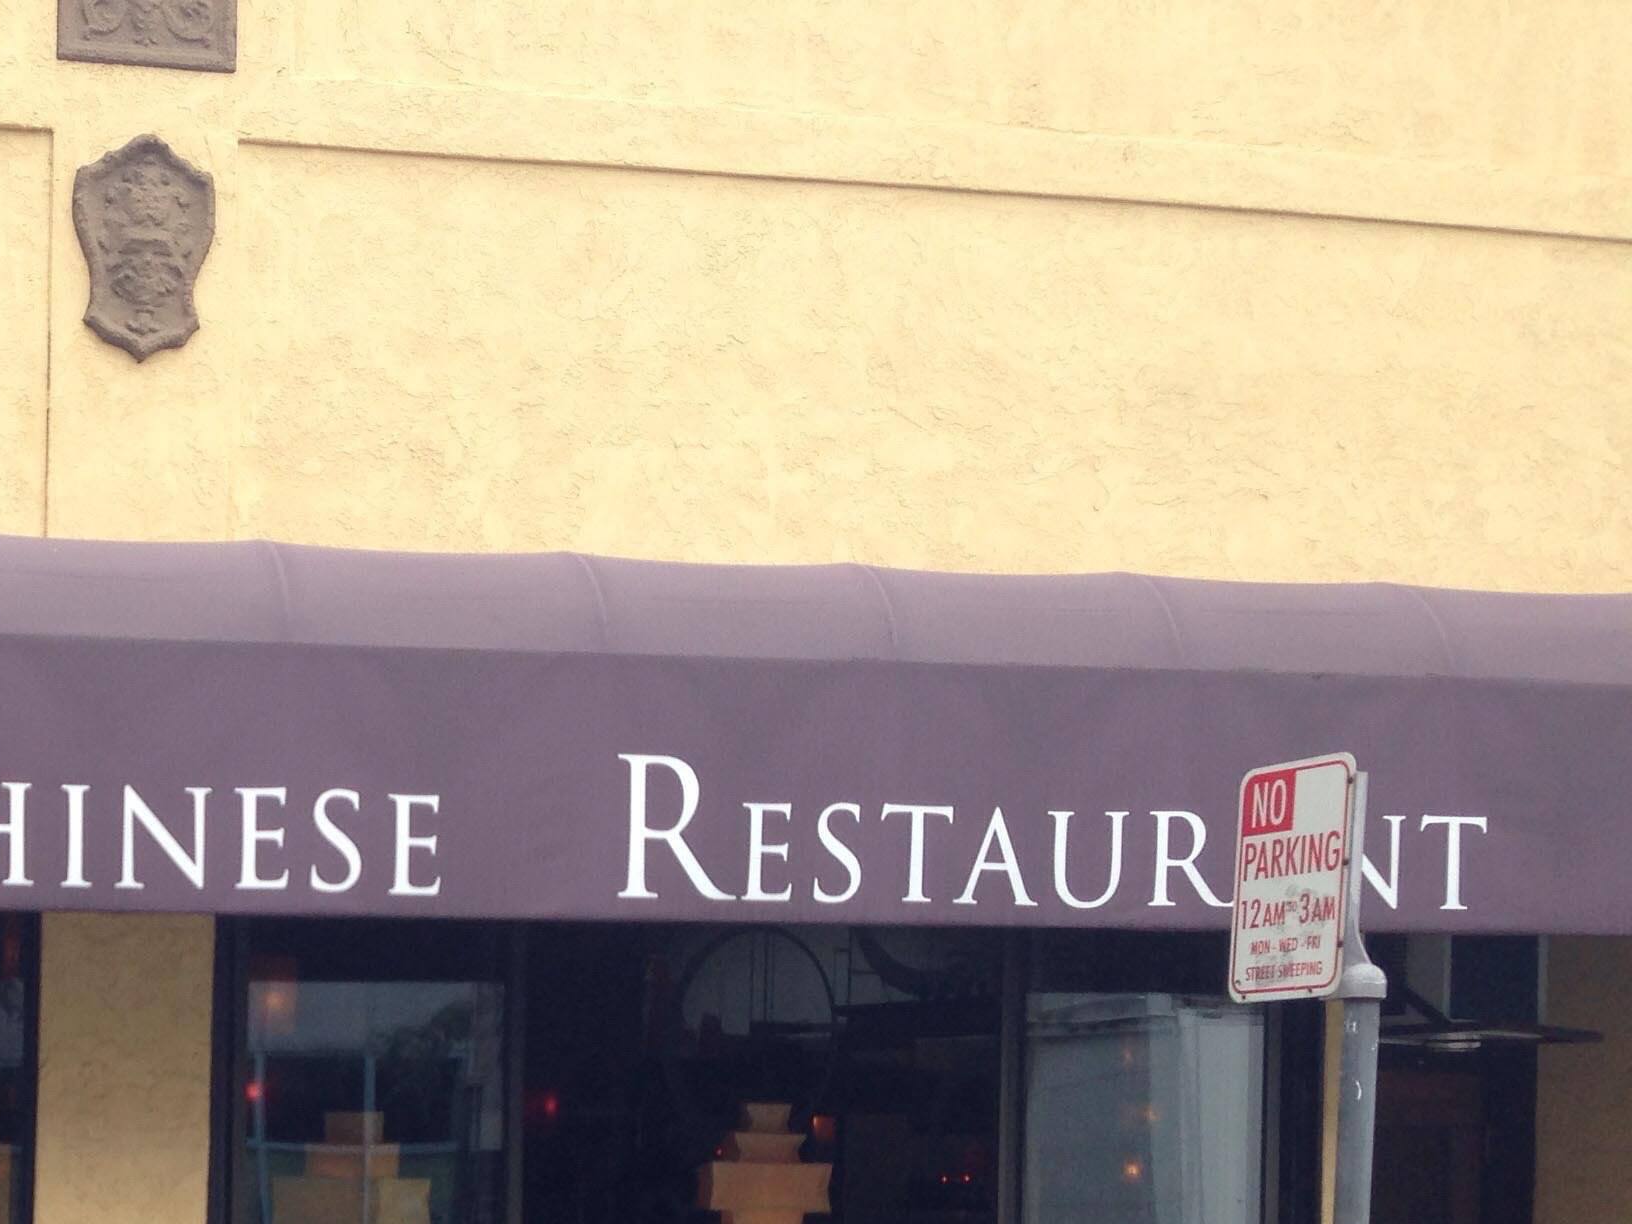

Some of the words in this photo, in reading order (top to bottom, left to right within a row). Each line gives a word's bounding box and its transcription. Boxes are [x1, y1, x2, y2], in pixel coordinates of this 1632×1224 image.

[1251, 778, 1288, 829] NO
[616, 752, 1488, 911] RESTAURNT
[1242, 830, 1342, 883] PARKING
[1245, 963, 1276, 982] STREET
[1278, 960, 1323, 979] SWEEPING
[1250, 939, 1271, 956] MON
[1279, 937, 1297, 953] WED
